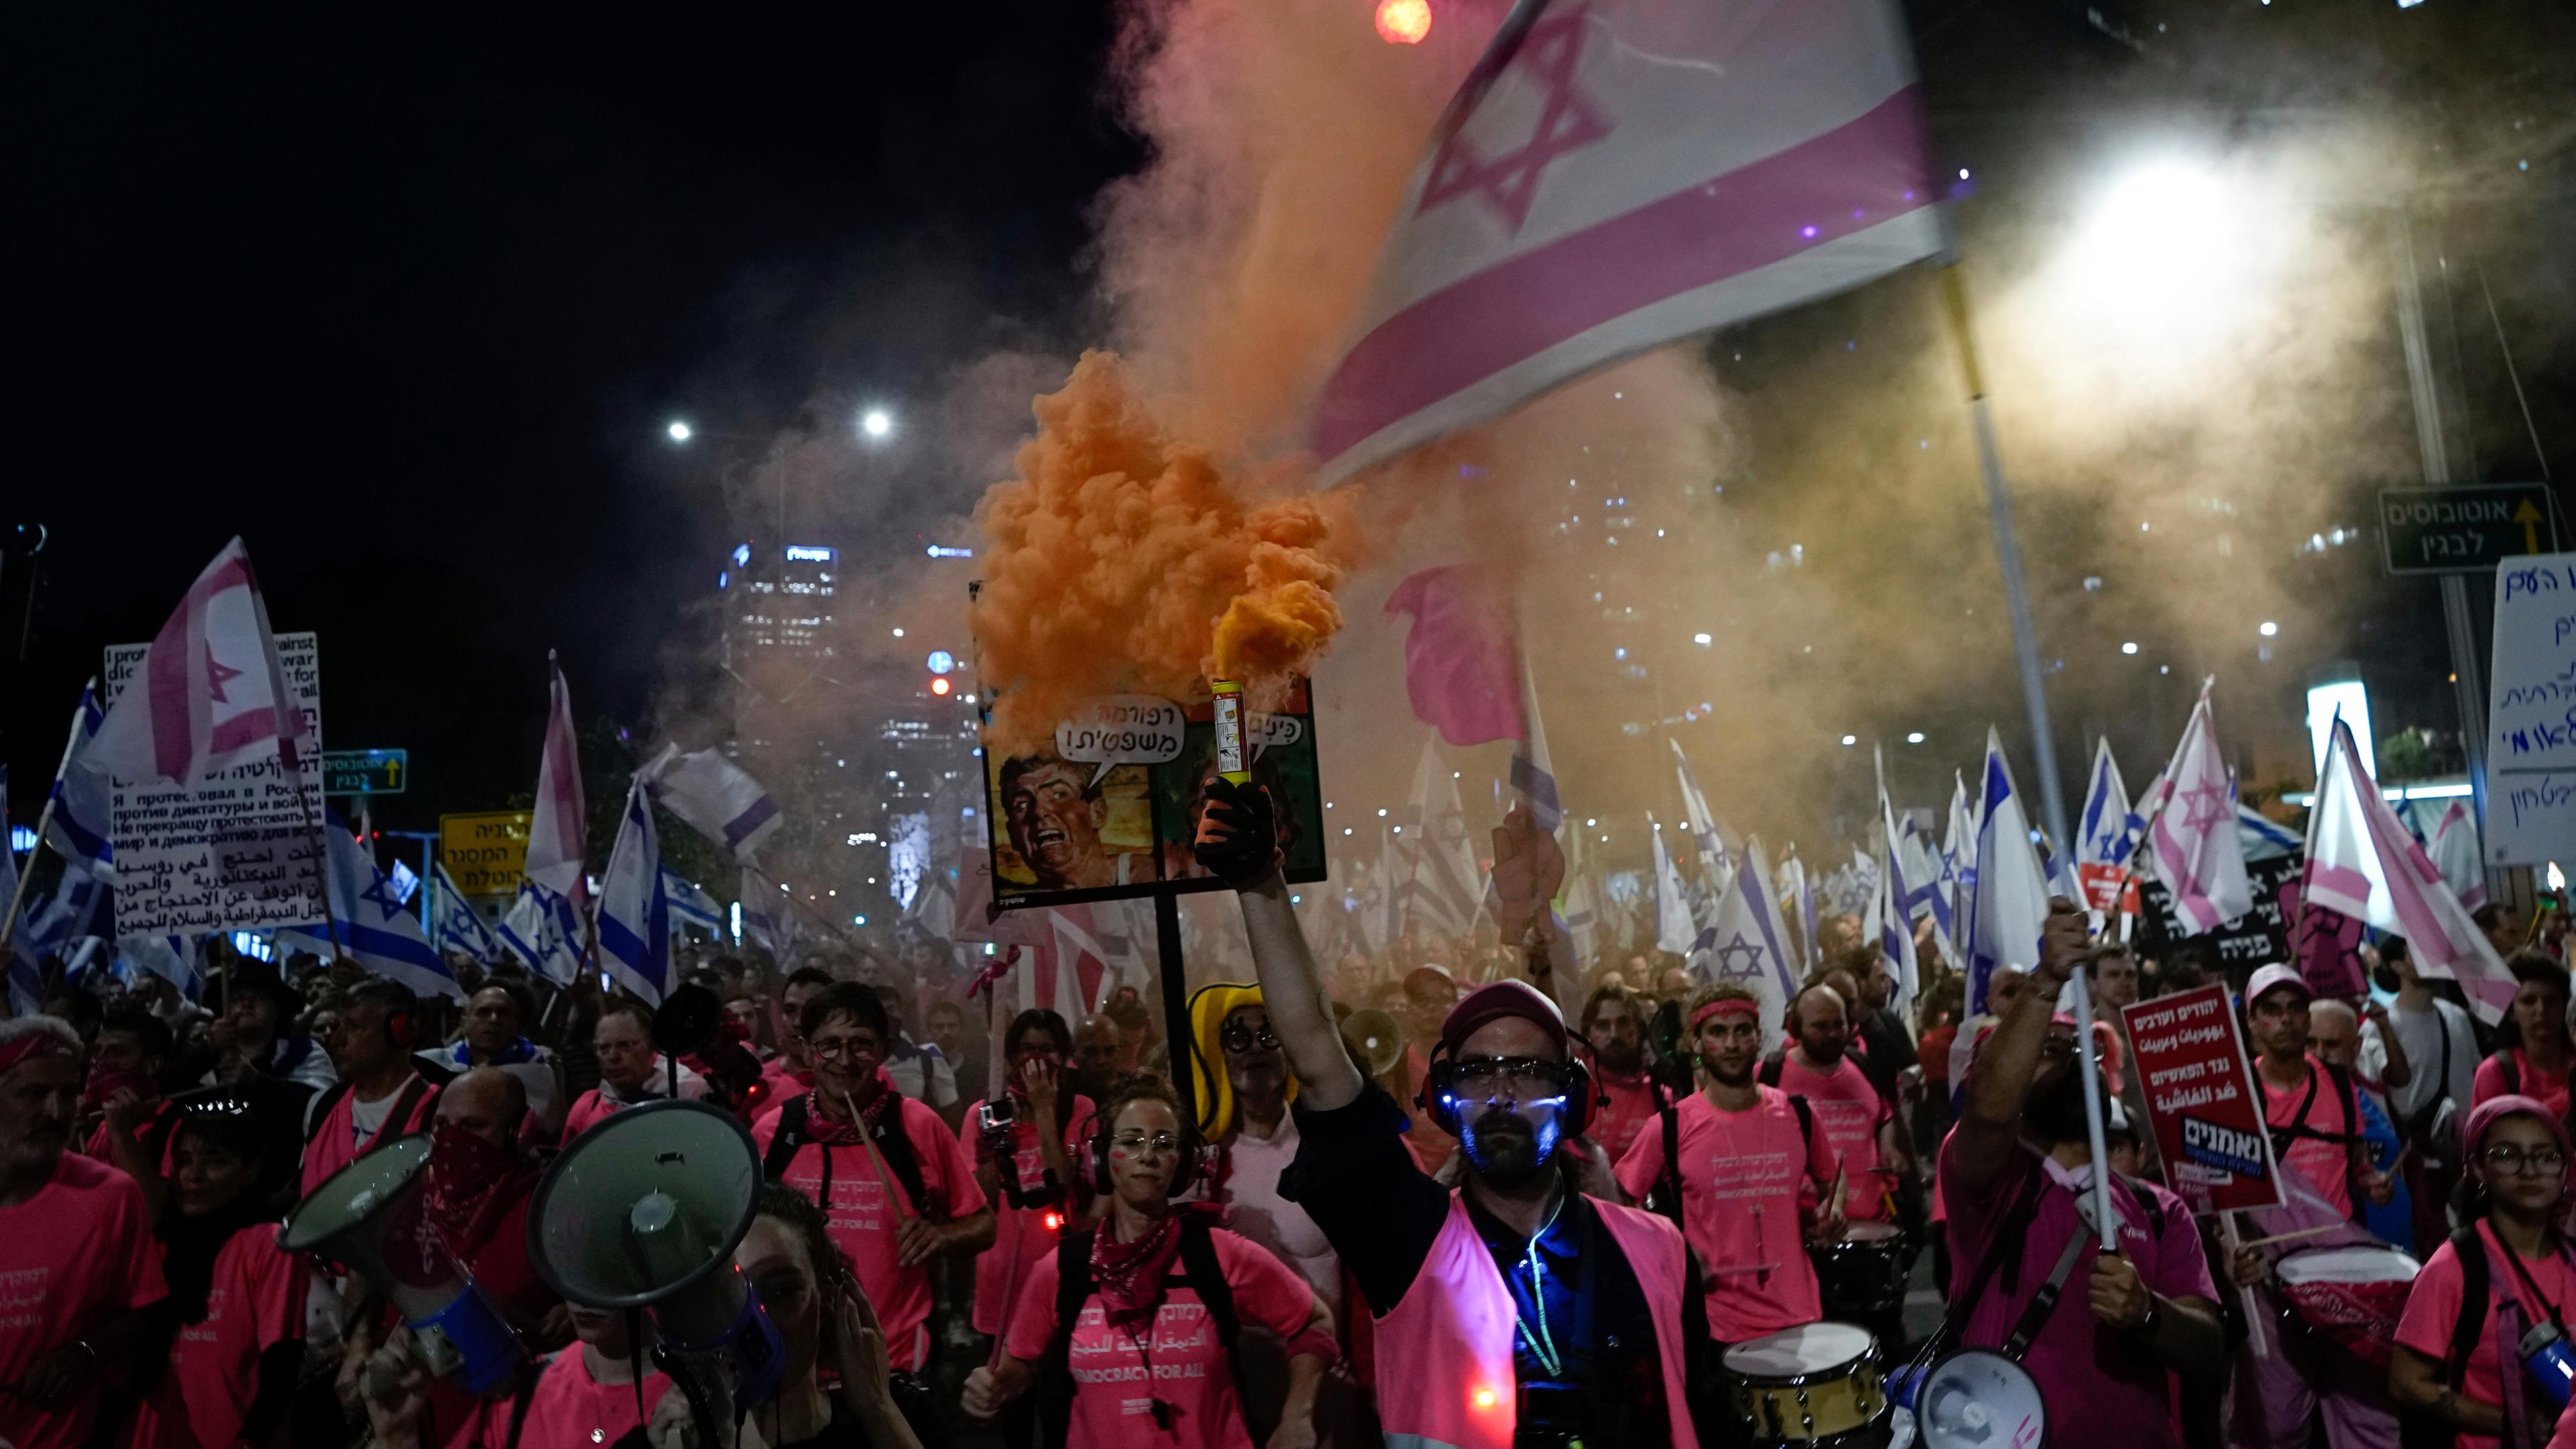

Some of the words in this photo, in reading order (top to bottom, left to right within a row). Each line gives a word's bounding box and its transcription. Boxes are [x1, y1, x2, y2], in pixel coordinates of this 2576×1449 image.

[2389, 499, 2510, 526] אוטובוסים
[2422, 528, 2483, 563] לבגין
[281, 654, 313, 665] war
[295, 669, 315, 681] for
[301, 685, 317, 697] all
[113, 794, 123, 806] Я
[137, 788, 235, 807] протесовал
[244, 788, 254, 797] в
[113, 808, 168, 822] против
[172, 801, 254, 818] диктатуры
[258, 800, 268, 810] и
[136, 818, 208, 836] прекращу
[211, 812, 303, 830] протестовать
[113, 839, 145, 852] мир
[149, 837, 159, 847] и
[2184, 1117, 2262, 1165] נאמנים
[1153, 1363, 1182, 1381] FOR
[1183, 1362, 1207, 1379] ALL
